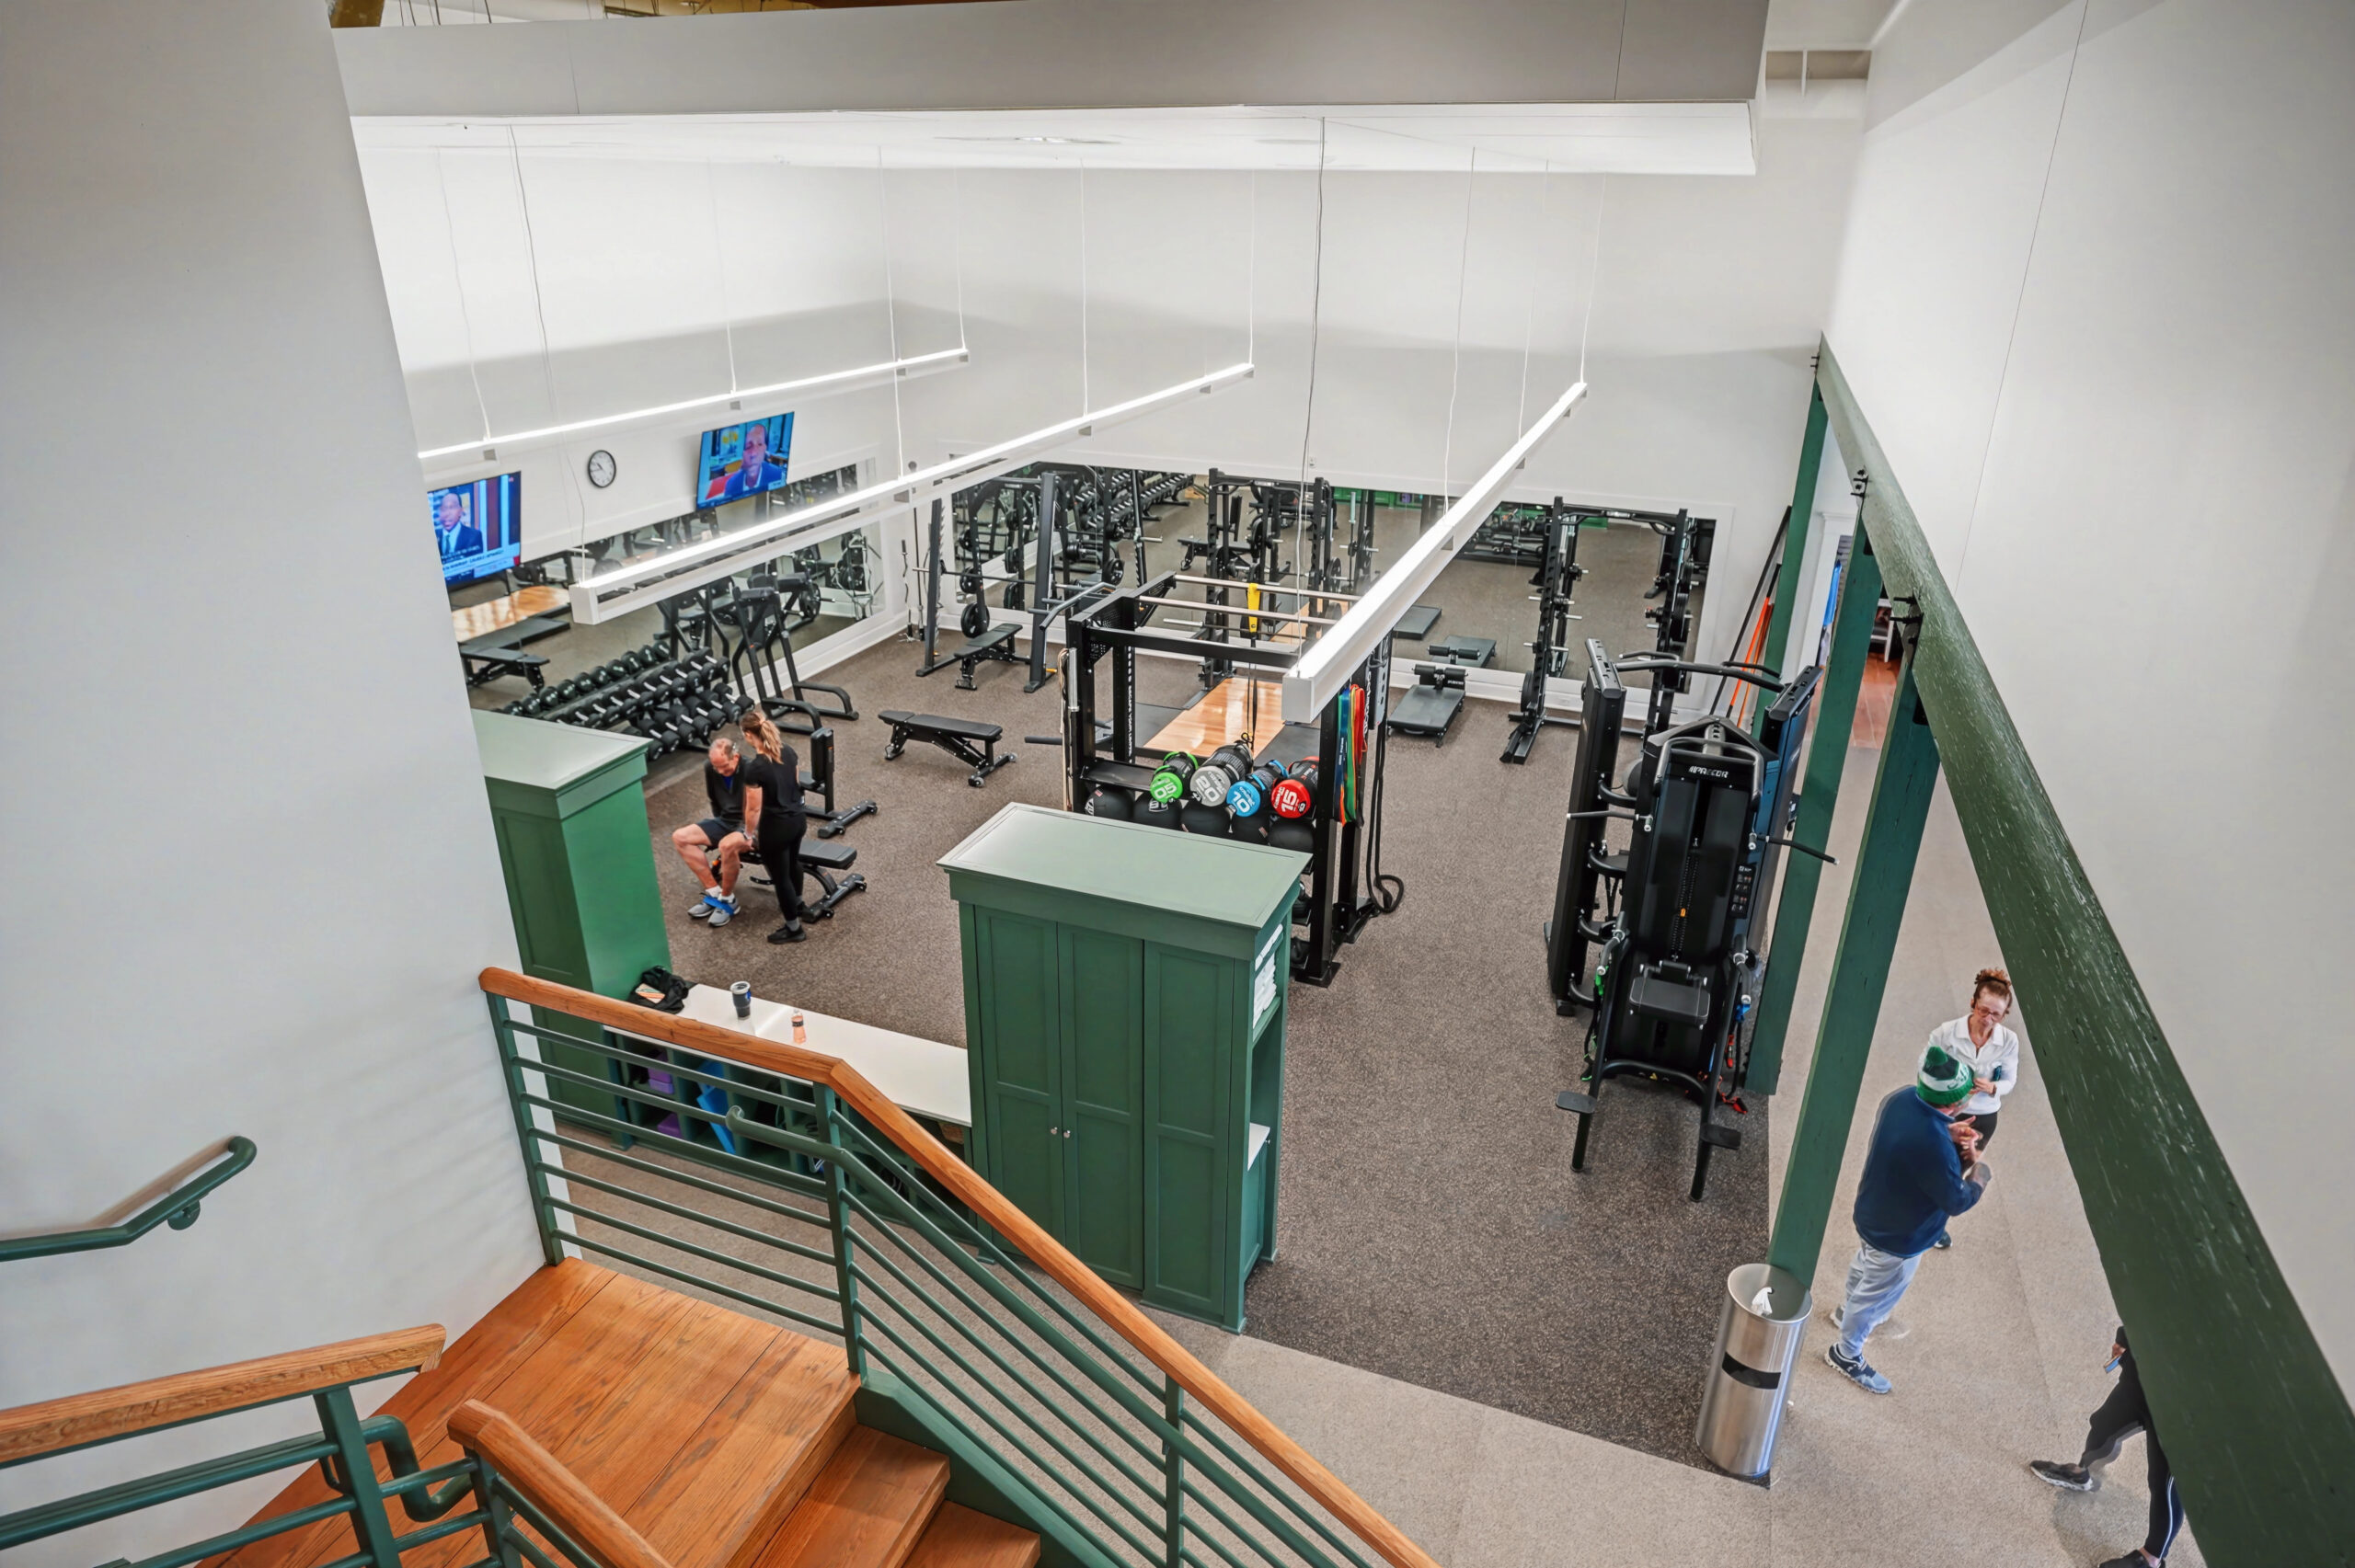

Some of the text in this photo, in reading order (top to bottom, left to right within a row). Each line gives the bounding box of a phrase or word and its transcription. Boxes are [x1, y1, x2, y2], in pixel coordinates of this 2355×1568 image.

[1154, 782, 1178, 799] 05
[1196, 775, 1220, 802] 20
[1233, 791, 1251, 813] 10
[1281, 789, 1297, 812] 15
